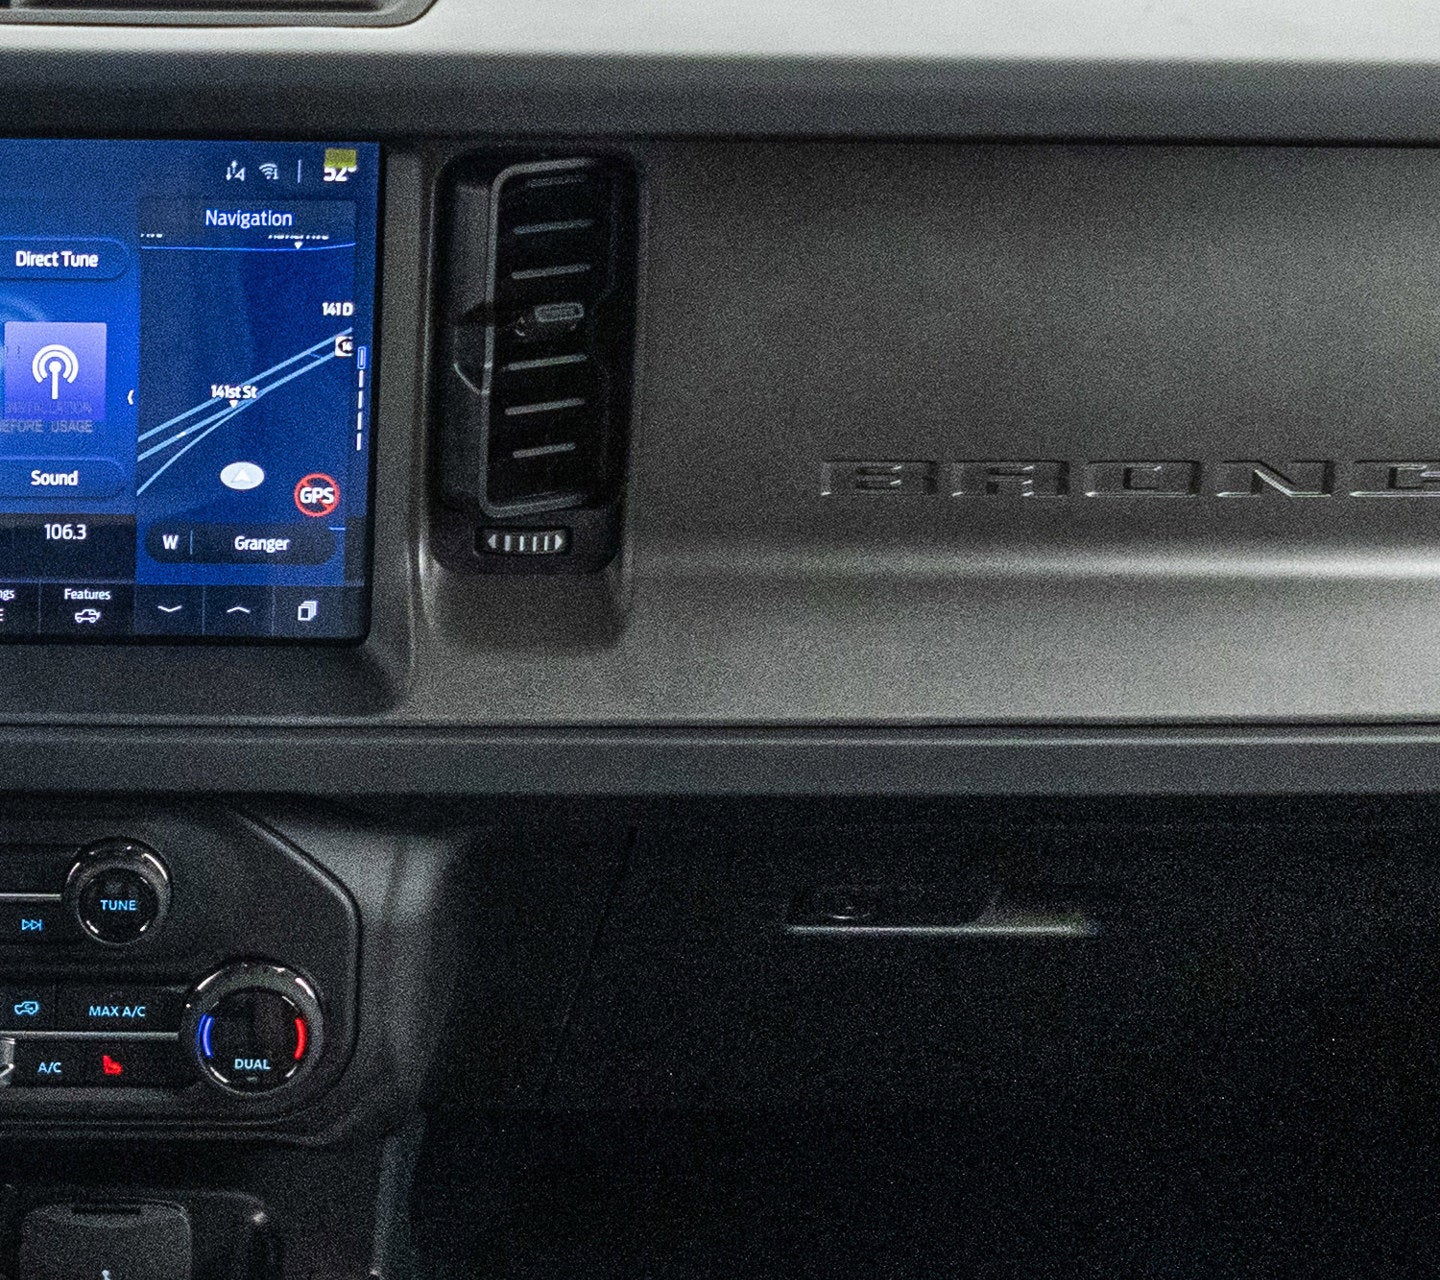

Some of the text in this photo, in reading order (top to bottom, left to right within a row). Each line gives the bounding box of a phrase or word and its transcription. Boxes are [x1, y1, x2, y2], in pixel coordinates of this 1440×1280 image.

[205, 208, 293, 230] Navigation
[15, 249, 99, 269] Direct Tune
[210, 384, 258, 400] 141st St
[51, 419, 94, 434] USAGE
[30, 468, 78, 488] Sound
[298, 484, 335, 506] GPS
[44, 522, 88, 541] 106.3
[162, 534, 179, 551] W
[234, 534, 290, 557] Granger
[63, 587, 112, 602] Features
[100, 898, 138, 912] TUNE
[88, 1004, 147, 1019] MAX A/C
[37, 1060, 63, 1074] A/C
[234, 1057, 271, 1071] DUAL
